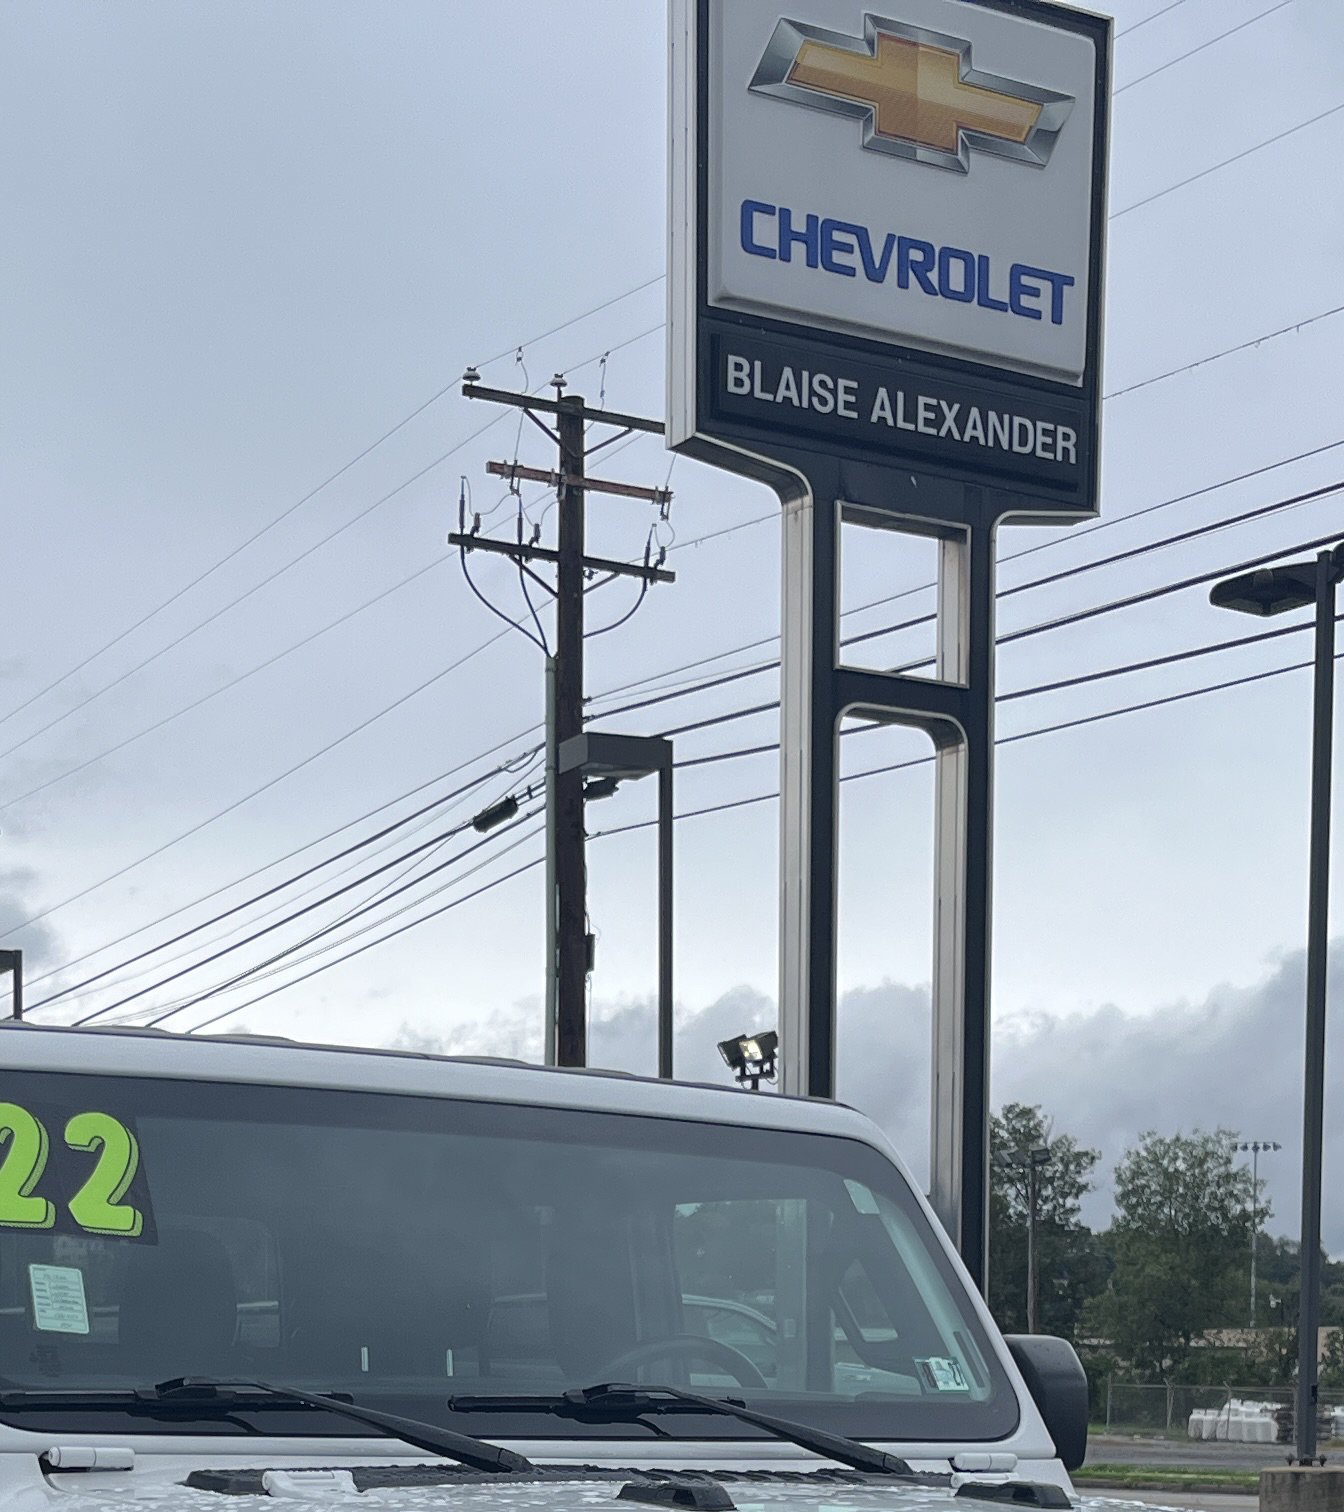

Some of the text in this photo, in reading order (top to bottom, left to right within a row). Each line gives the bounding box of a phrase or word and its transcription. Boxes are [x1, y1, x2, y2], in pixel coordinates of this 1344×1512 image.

[740, 198, 1075, 325] CHEVROLET
[726, 354, 1078, 465] BLAISE ALEXANDER
